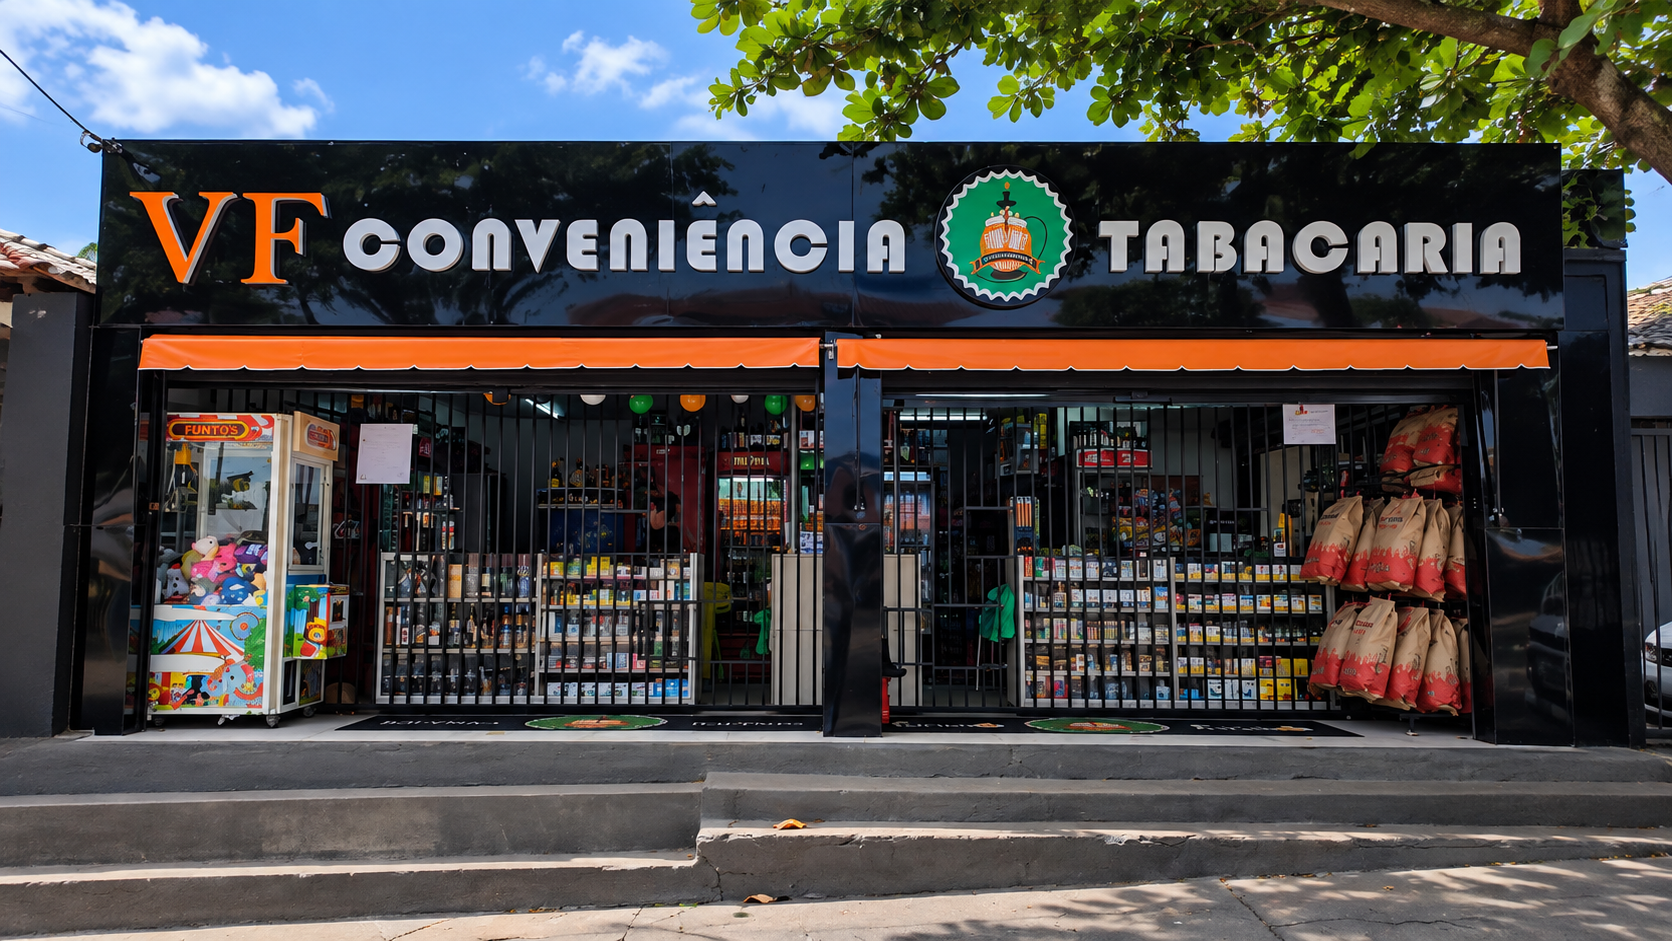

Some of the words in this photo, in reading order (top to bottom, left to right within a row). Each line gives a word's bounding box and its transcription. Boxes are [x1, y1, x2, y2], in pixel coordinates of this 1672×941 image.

[129, 191, 331, 285] VF
[343, 191, 906, 274] CONVENIÊNCIA
[1098, 219, 1521, 275] TABACARIA
